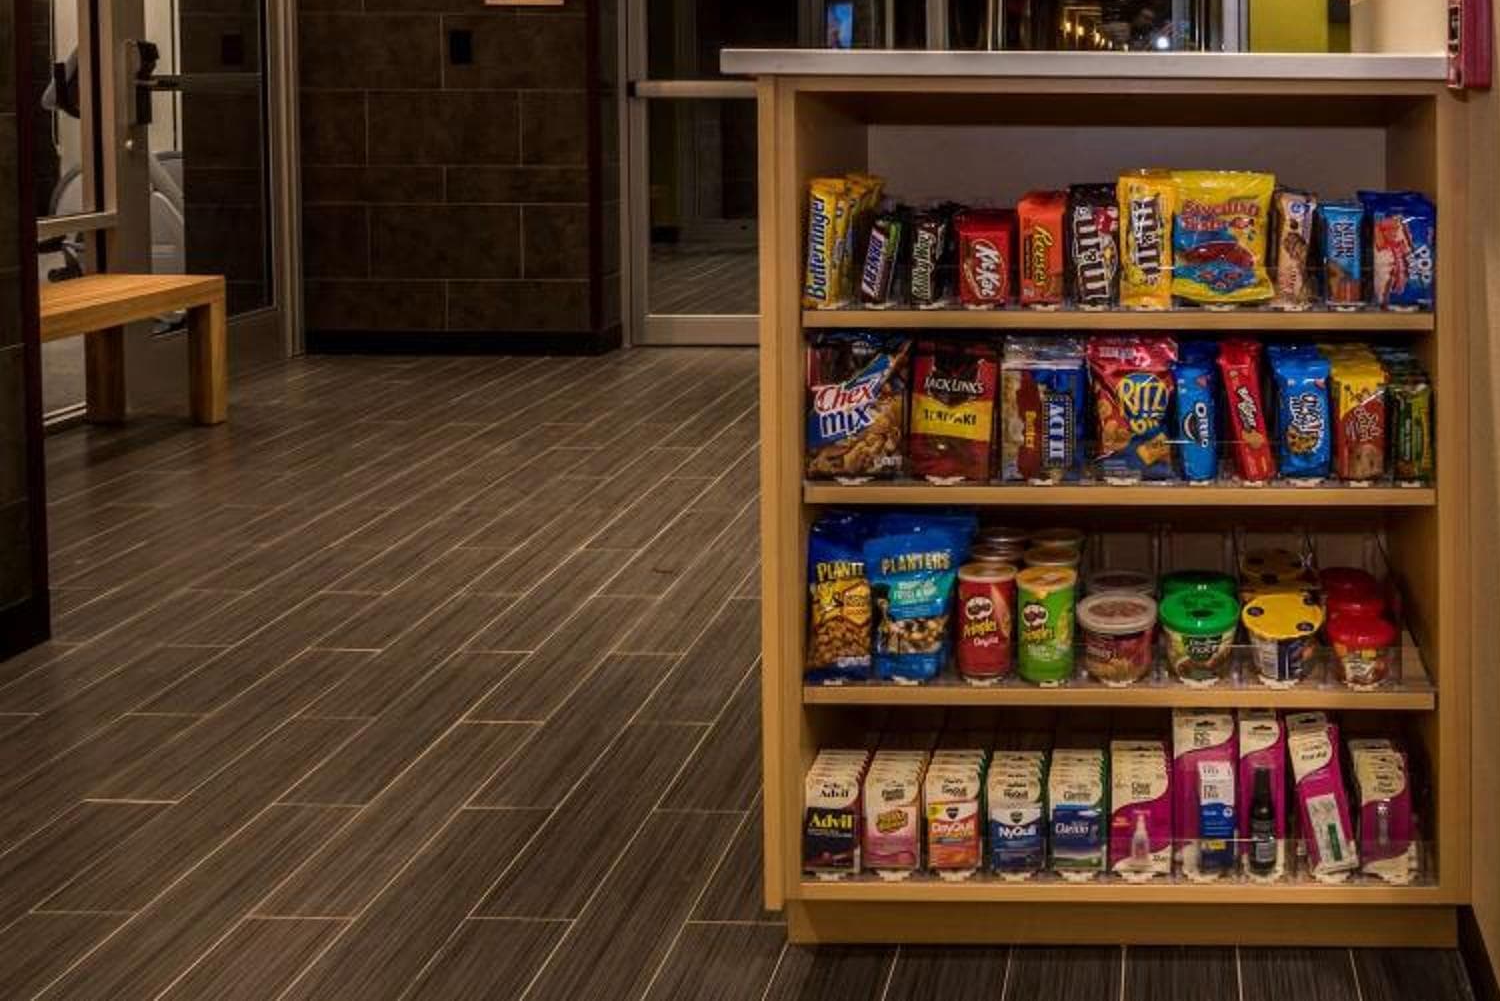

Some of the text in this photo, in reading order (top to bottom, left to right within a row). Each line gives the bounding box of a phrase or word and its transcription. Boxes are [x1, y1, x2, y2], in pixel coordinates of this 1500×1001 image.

[806, 198, 829, 300] Butterfinger
[812, 376, 880, 413] Chex
[924, 376, 950, 392] JACK
[1119, 378, 1166, 416] RITZ
[881, 550, 951, 576] PLANTERS
[809, 813, 853, 829] Advil
[999, 826, 1037, 839] NyQuil
